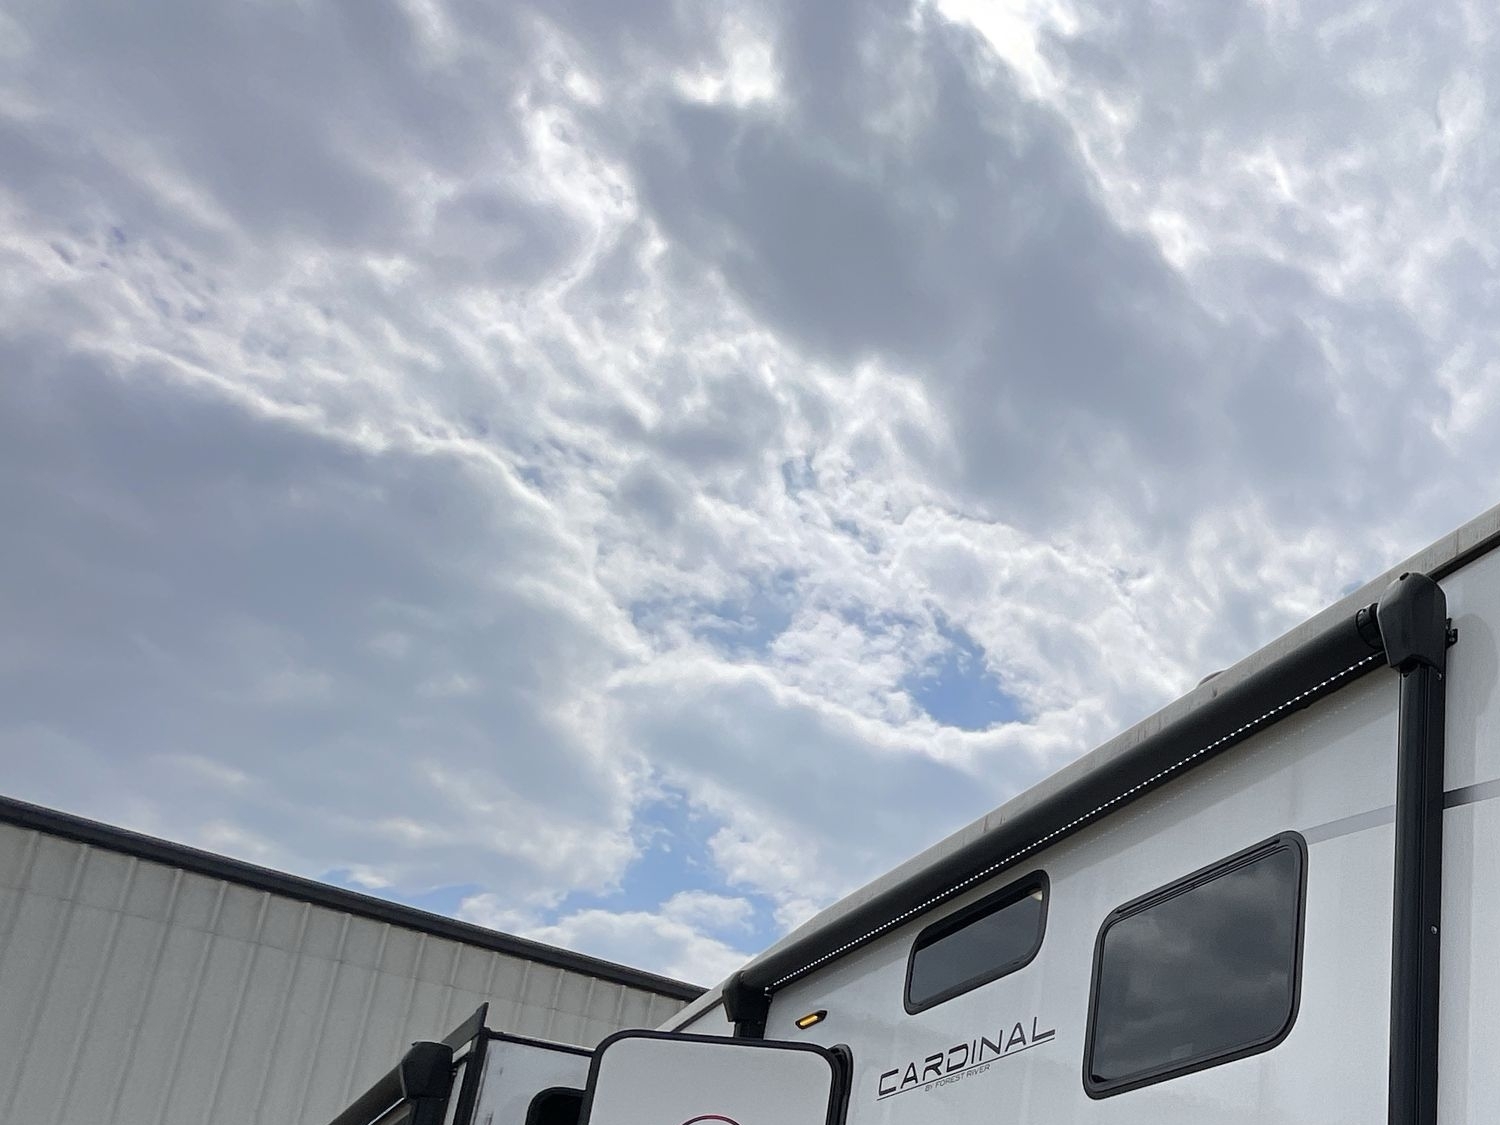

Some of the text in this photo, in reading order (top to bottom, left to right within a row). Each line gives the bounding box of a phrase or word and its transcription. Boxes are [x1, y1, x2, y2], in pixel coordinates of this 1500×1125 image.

[878, 1016, 1056, 1096] CARDINAL
[935, 1073, 965, 1088] FOREST
[966, 1064, 991, 1078] RIVER
